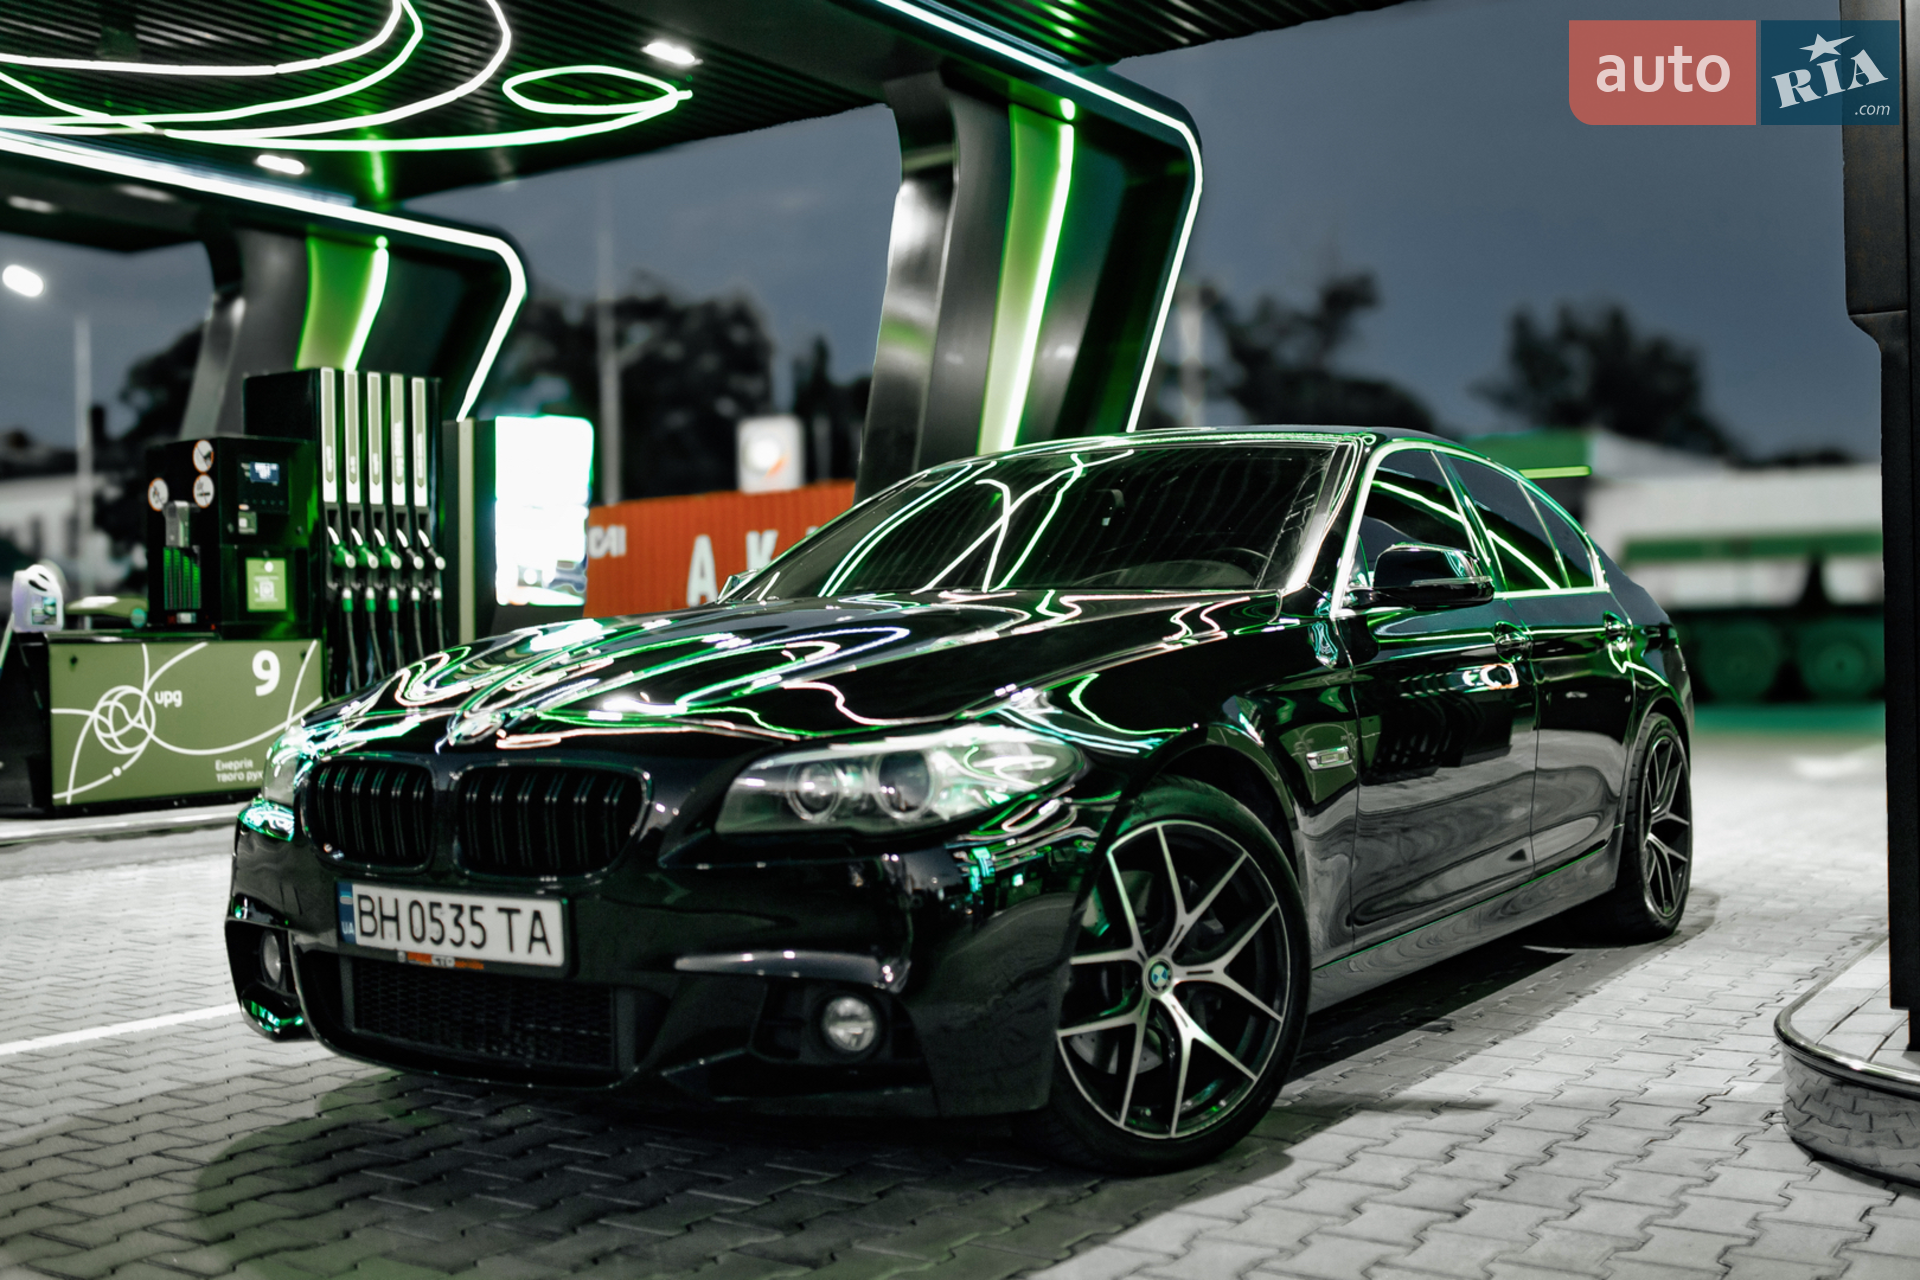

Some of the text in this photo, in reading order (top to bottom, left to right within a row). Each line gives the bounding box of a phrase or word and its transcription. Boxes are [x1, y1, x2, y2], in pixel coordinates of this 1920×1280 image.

[252, 649, 281, 697] 9
[154, 690, 183, 708] upg
[357, 894, 552, 955] BH 0535 TA
